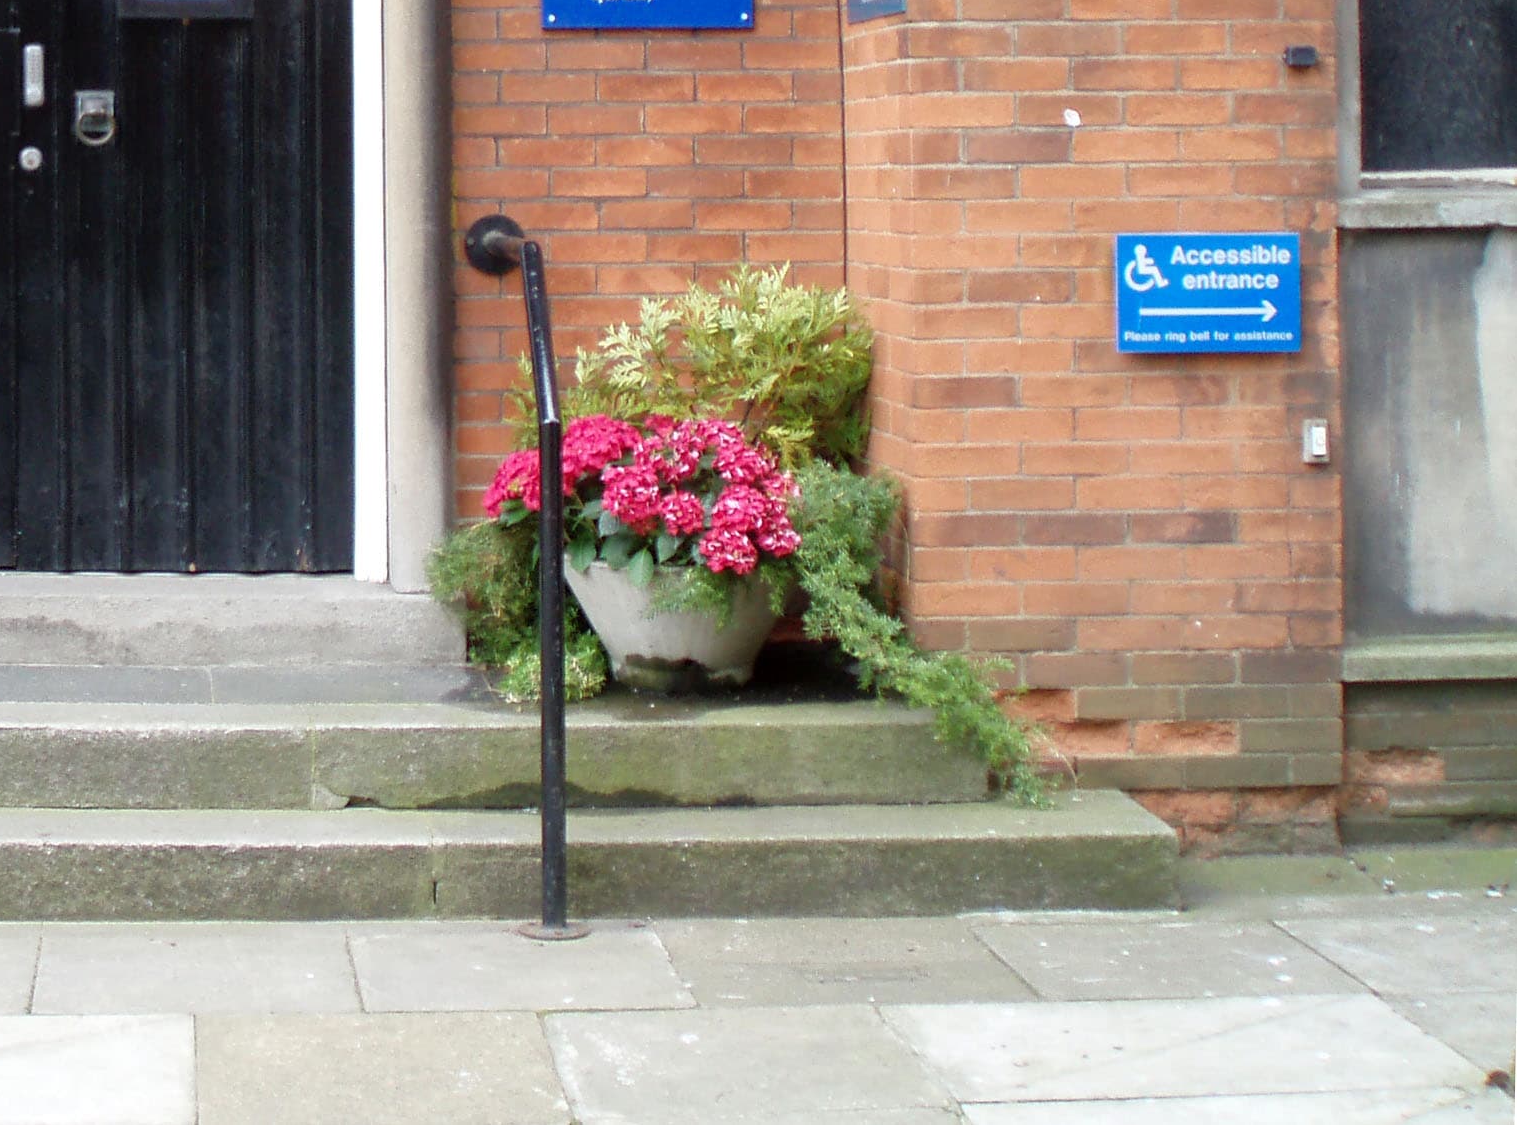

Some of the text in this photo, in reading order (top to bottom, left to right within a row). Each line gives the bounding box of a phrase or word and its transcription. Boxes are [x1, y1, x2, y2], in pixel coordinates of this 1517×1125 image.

[1170, 245, 1292, 265] Accessible
[1181, 271, 1280, 290] entrance
[1123, 329, 1294, 344] Please ring bell for assistance
